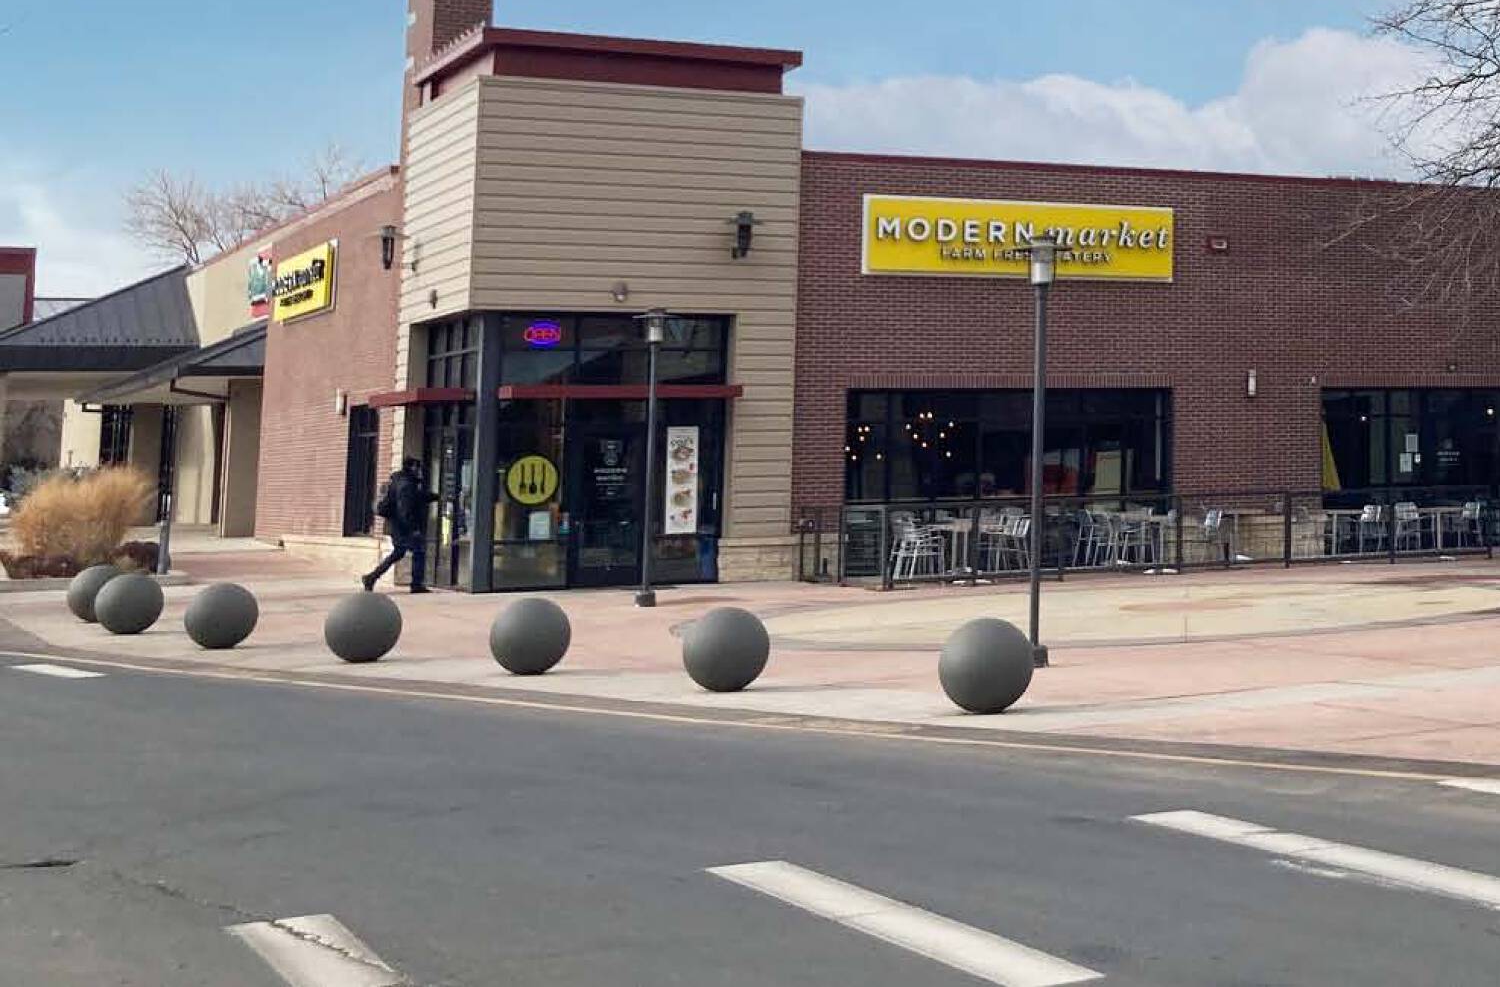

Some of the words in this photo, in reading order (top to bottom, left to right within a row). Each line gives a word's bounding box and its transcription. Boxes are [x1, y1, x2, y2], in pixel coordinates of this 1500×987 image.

[875, 216, 1034, 244] MODERN
[1046, 219, 1169, 250] market
[993, 248, 1042, 262] FRES
